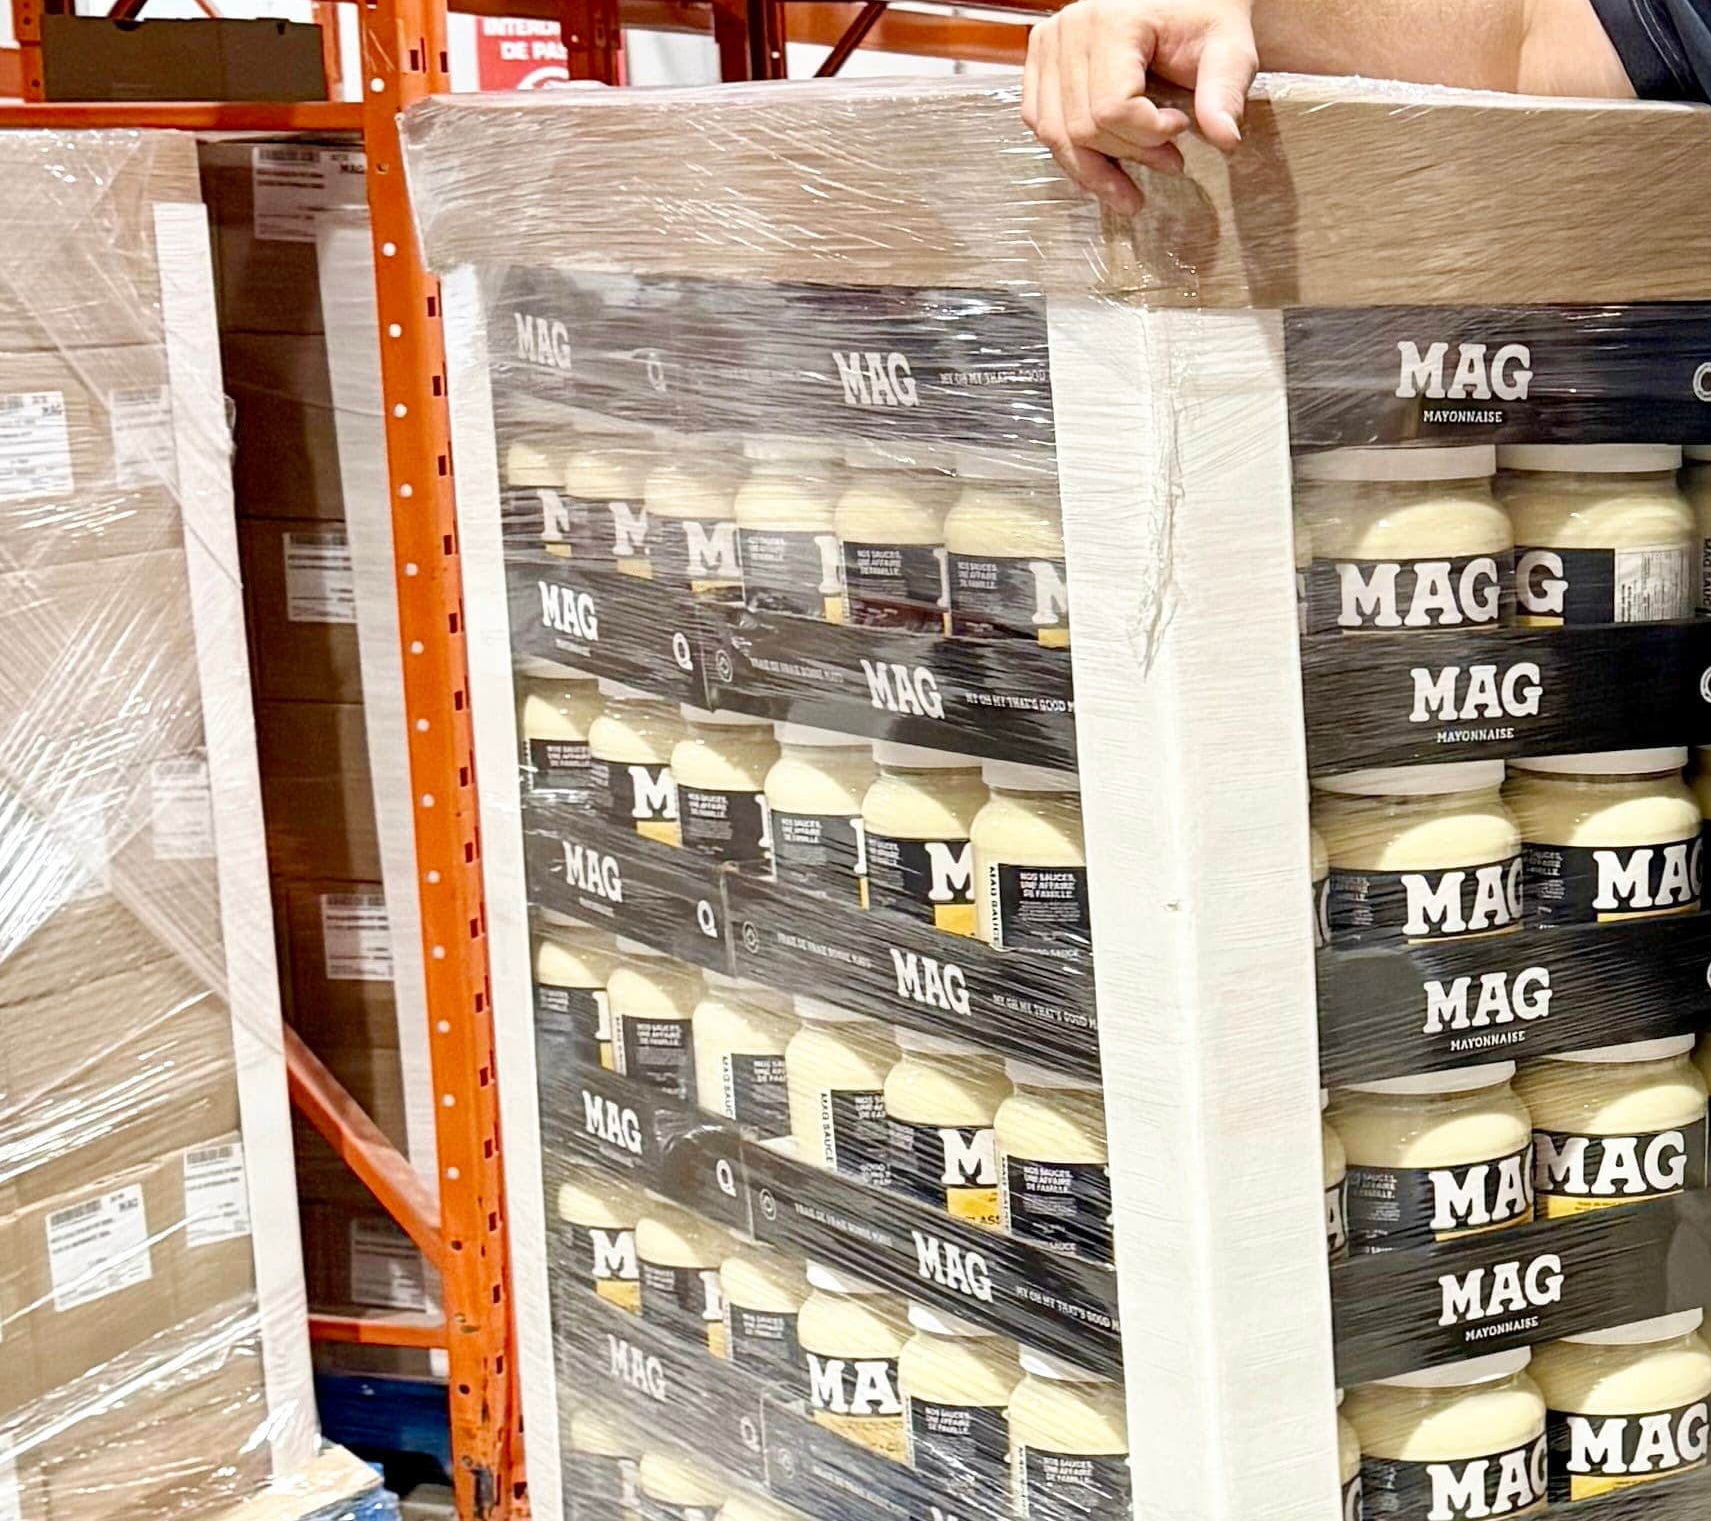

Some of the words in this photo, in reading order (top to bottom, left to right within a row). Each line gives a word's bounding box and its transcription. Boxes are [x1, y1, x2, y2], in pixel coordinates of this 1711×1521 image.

[501, 41, 529, 61] DE
[514, 313, 572, 369] MAG
[1395, 341, 1533, 401] MAG
[832, 352, 919, 407] MAG
[1423, 410, 1502, 423] MAYONNAISE
[538, 581, 598, 641] MAG
[1336, 557, 1500, 627] MAG
[860, 659, 945, 720] MAG
[1409, 663, 1543, 722] MAG
[1437, 728, 1514, 743] MAYONNAISE
[562, 839, 623, 903] MAG
[890, 948, 971, 1016] MAG
[1422, 967, 1552, 1034] MAG
[1450, 1030, 1526, 1052] MAYONNAISE
[582, 1090, 643, 1155] MAG
[1429, 1154, 1532, 1231] MA
[1537, 1131, 1687, 1194] MAG
[912, 1231, 993, 1303] MAG
[1437, 1254, 1564, 1325] MAG
[1465, 1316, 1539, 1342] MAYONNAISE
[608, 1334, 667, 1401] MAG
[807, 1353, 902, 1415] MA
[1566, 1402, 1710, 1475] MAG
